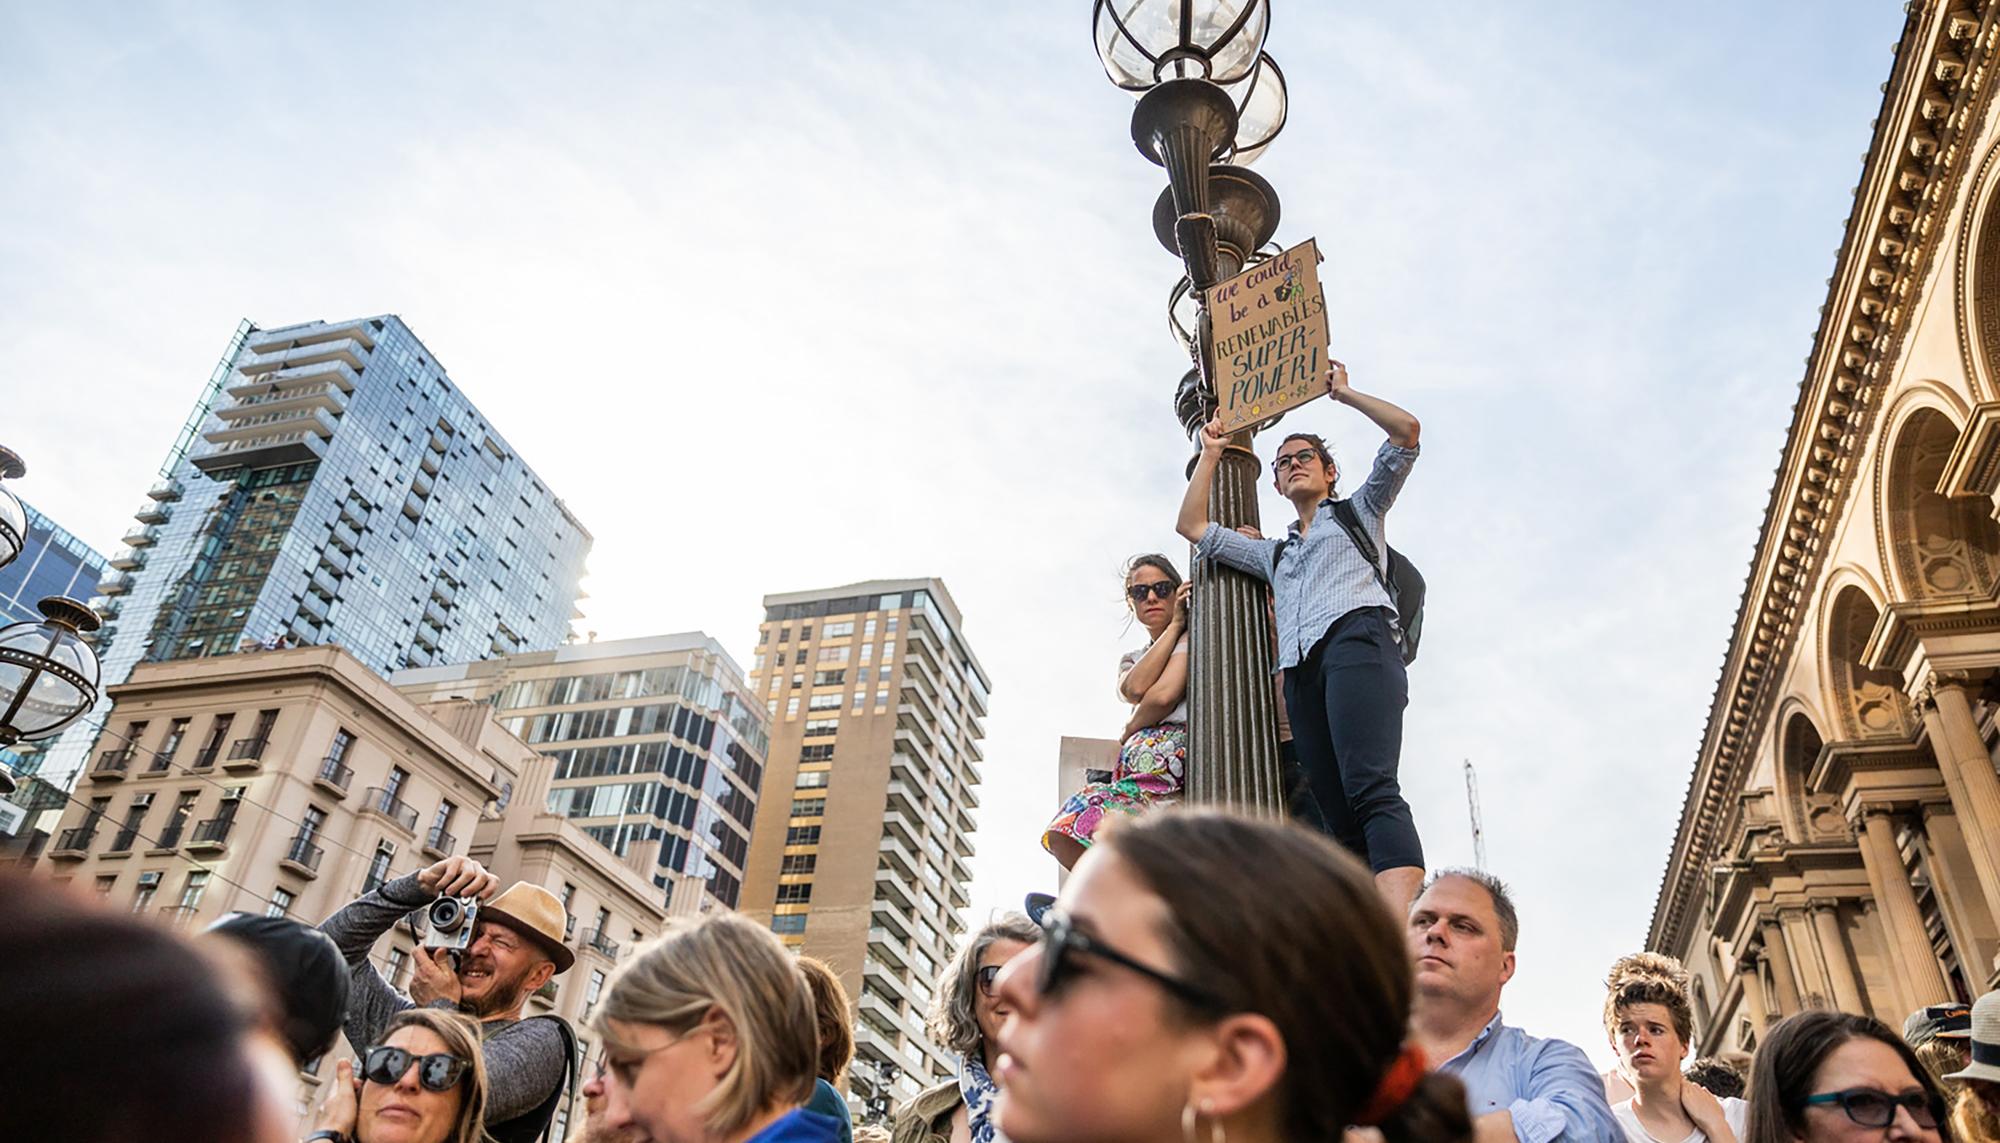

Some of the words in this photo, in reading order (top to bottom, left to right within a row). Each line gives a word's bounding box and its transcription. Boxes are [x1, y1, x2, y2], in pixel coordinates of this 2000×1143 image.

[1216, 282, 1239, 303] we
[1246, 253, 1292, 288] could
[1216, 295, 1323, 360] RENEWABLES
[1230, 303, 1248, 323] be
[1257, 294, 1269, 309] a
[1233, 325, 1316, 377] SUPER-
[1229, 348, 1317, 410] POWER!
